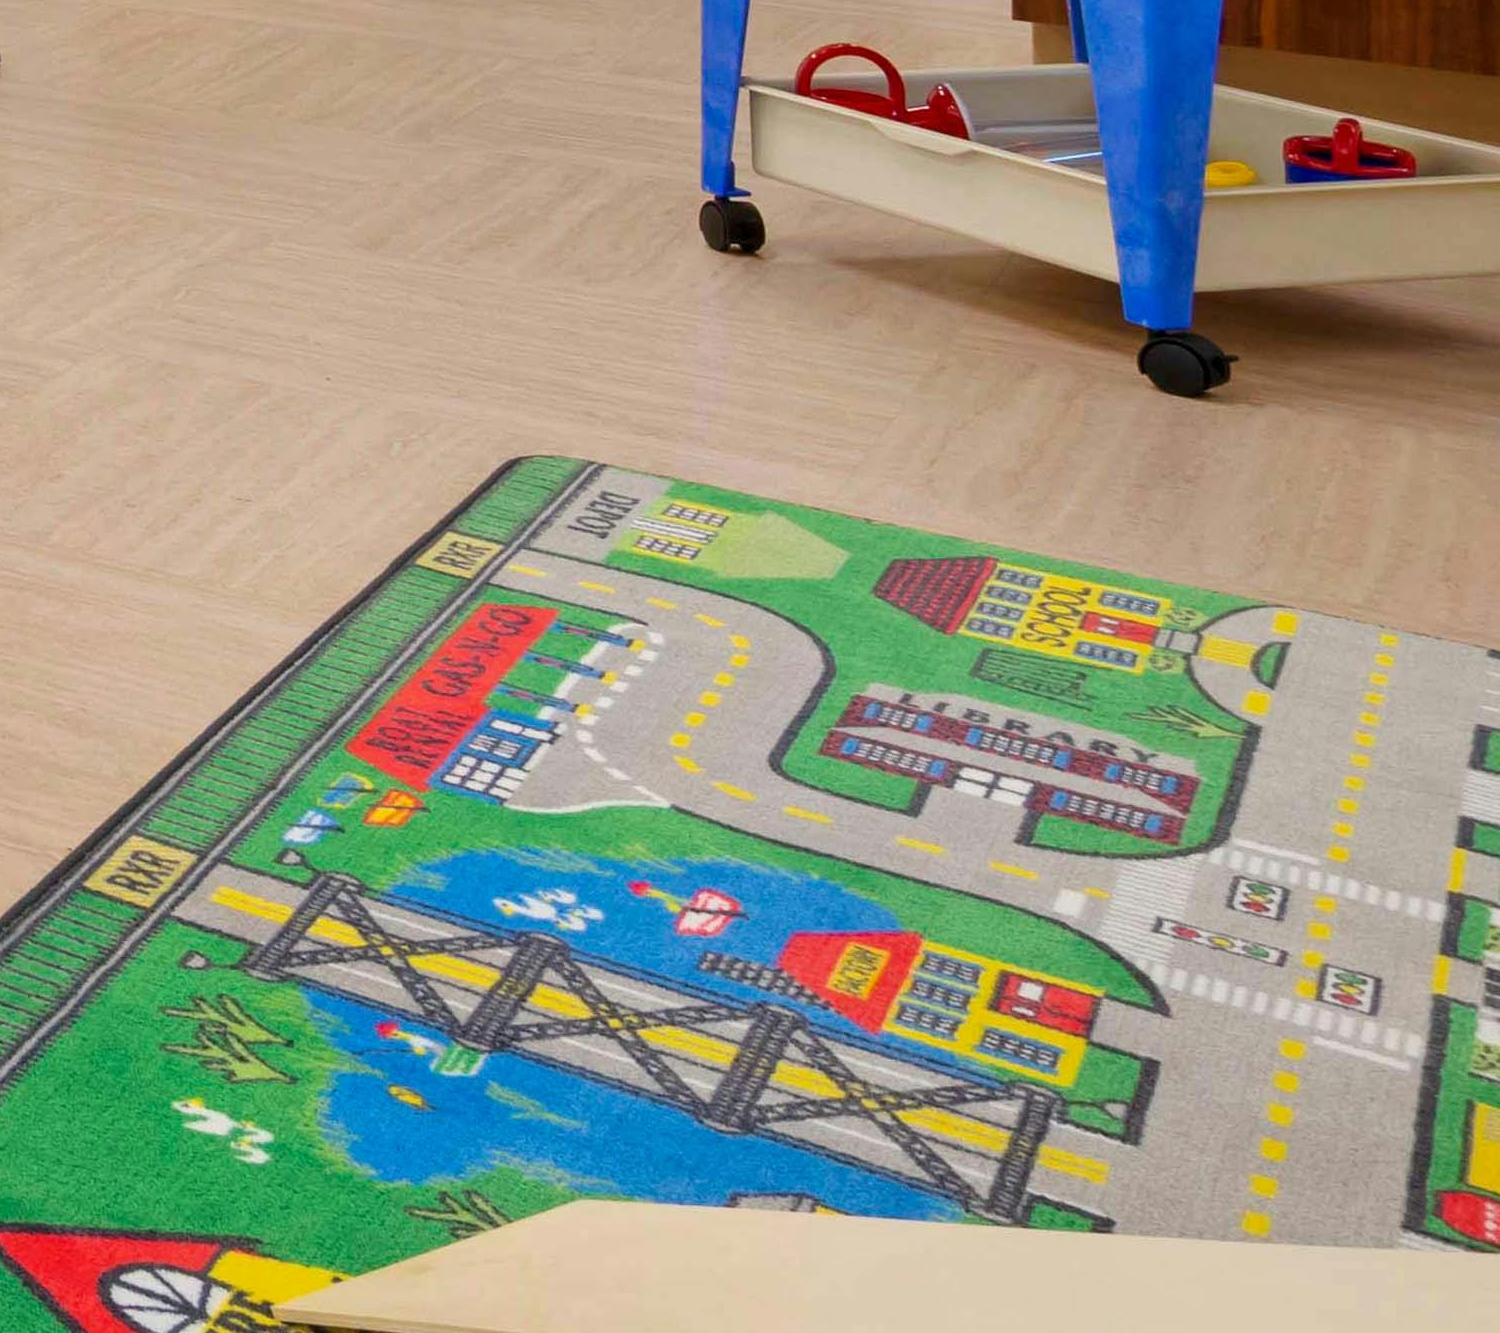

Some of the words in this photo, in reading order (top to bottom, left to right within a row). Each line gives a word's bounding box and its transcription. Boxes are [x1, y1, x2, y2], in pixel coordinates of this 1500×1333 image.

[566, 490, 641, 539] DEPOT
[433, 540, 495, 570] RXR
[1020, 585, 1093, 648] SCHOOL
[421, 606, 533, 698] GAS-N-GO
[366, 706, 426, 753] BOAT
[395, 710, 477, 769] RENTAL
[897, 693, 1159, 764] LIBRARY
[104, 849, 183, 896] RXR
